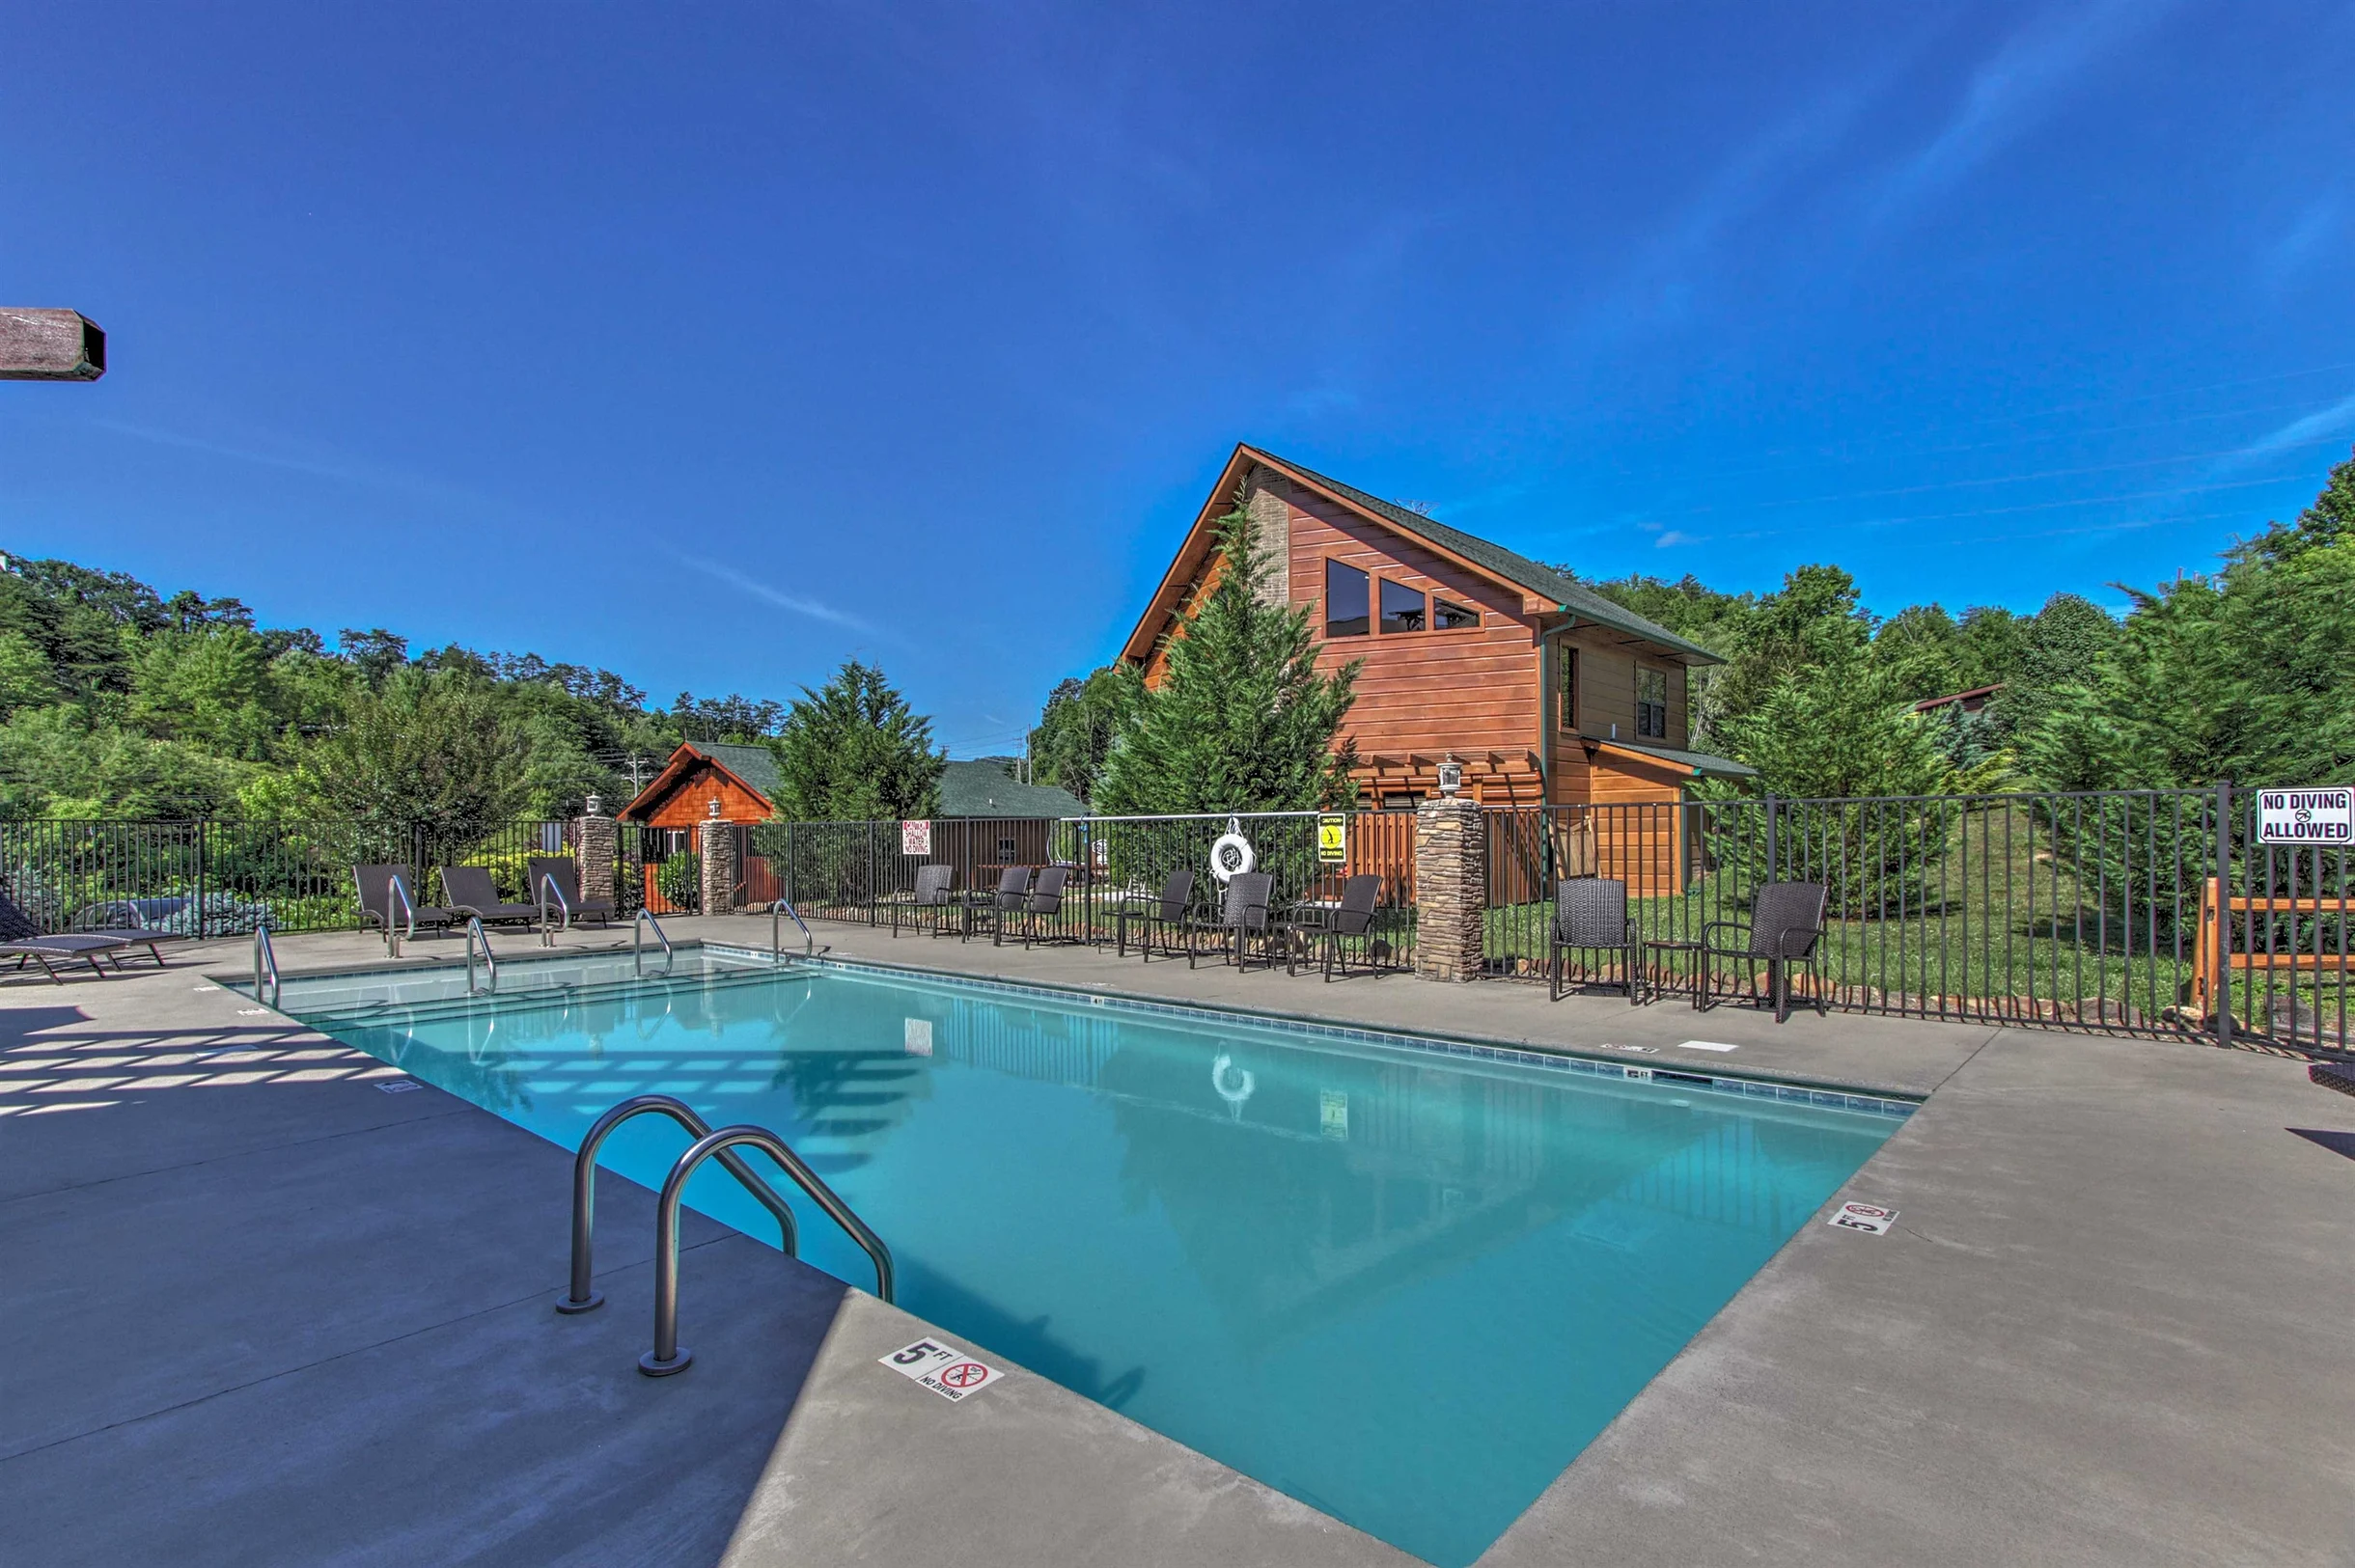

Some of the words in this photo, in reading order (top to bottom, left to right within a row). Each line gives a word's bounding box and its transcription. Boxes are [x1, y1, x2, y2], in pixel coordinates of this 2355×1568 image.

[2263, 794, 2285, 810] NO
[2289, 793, 2346, 809] DIVING
[2263, 822, 2348, 839] ALLOWED
[893, 1342, 939, 1364] 5
[933, 1351, 954, 1361] FT
[920, 1376, 933, 1386] NO
[933, 1383, 963, 1399] DIVING
